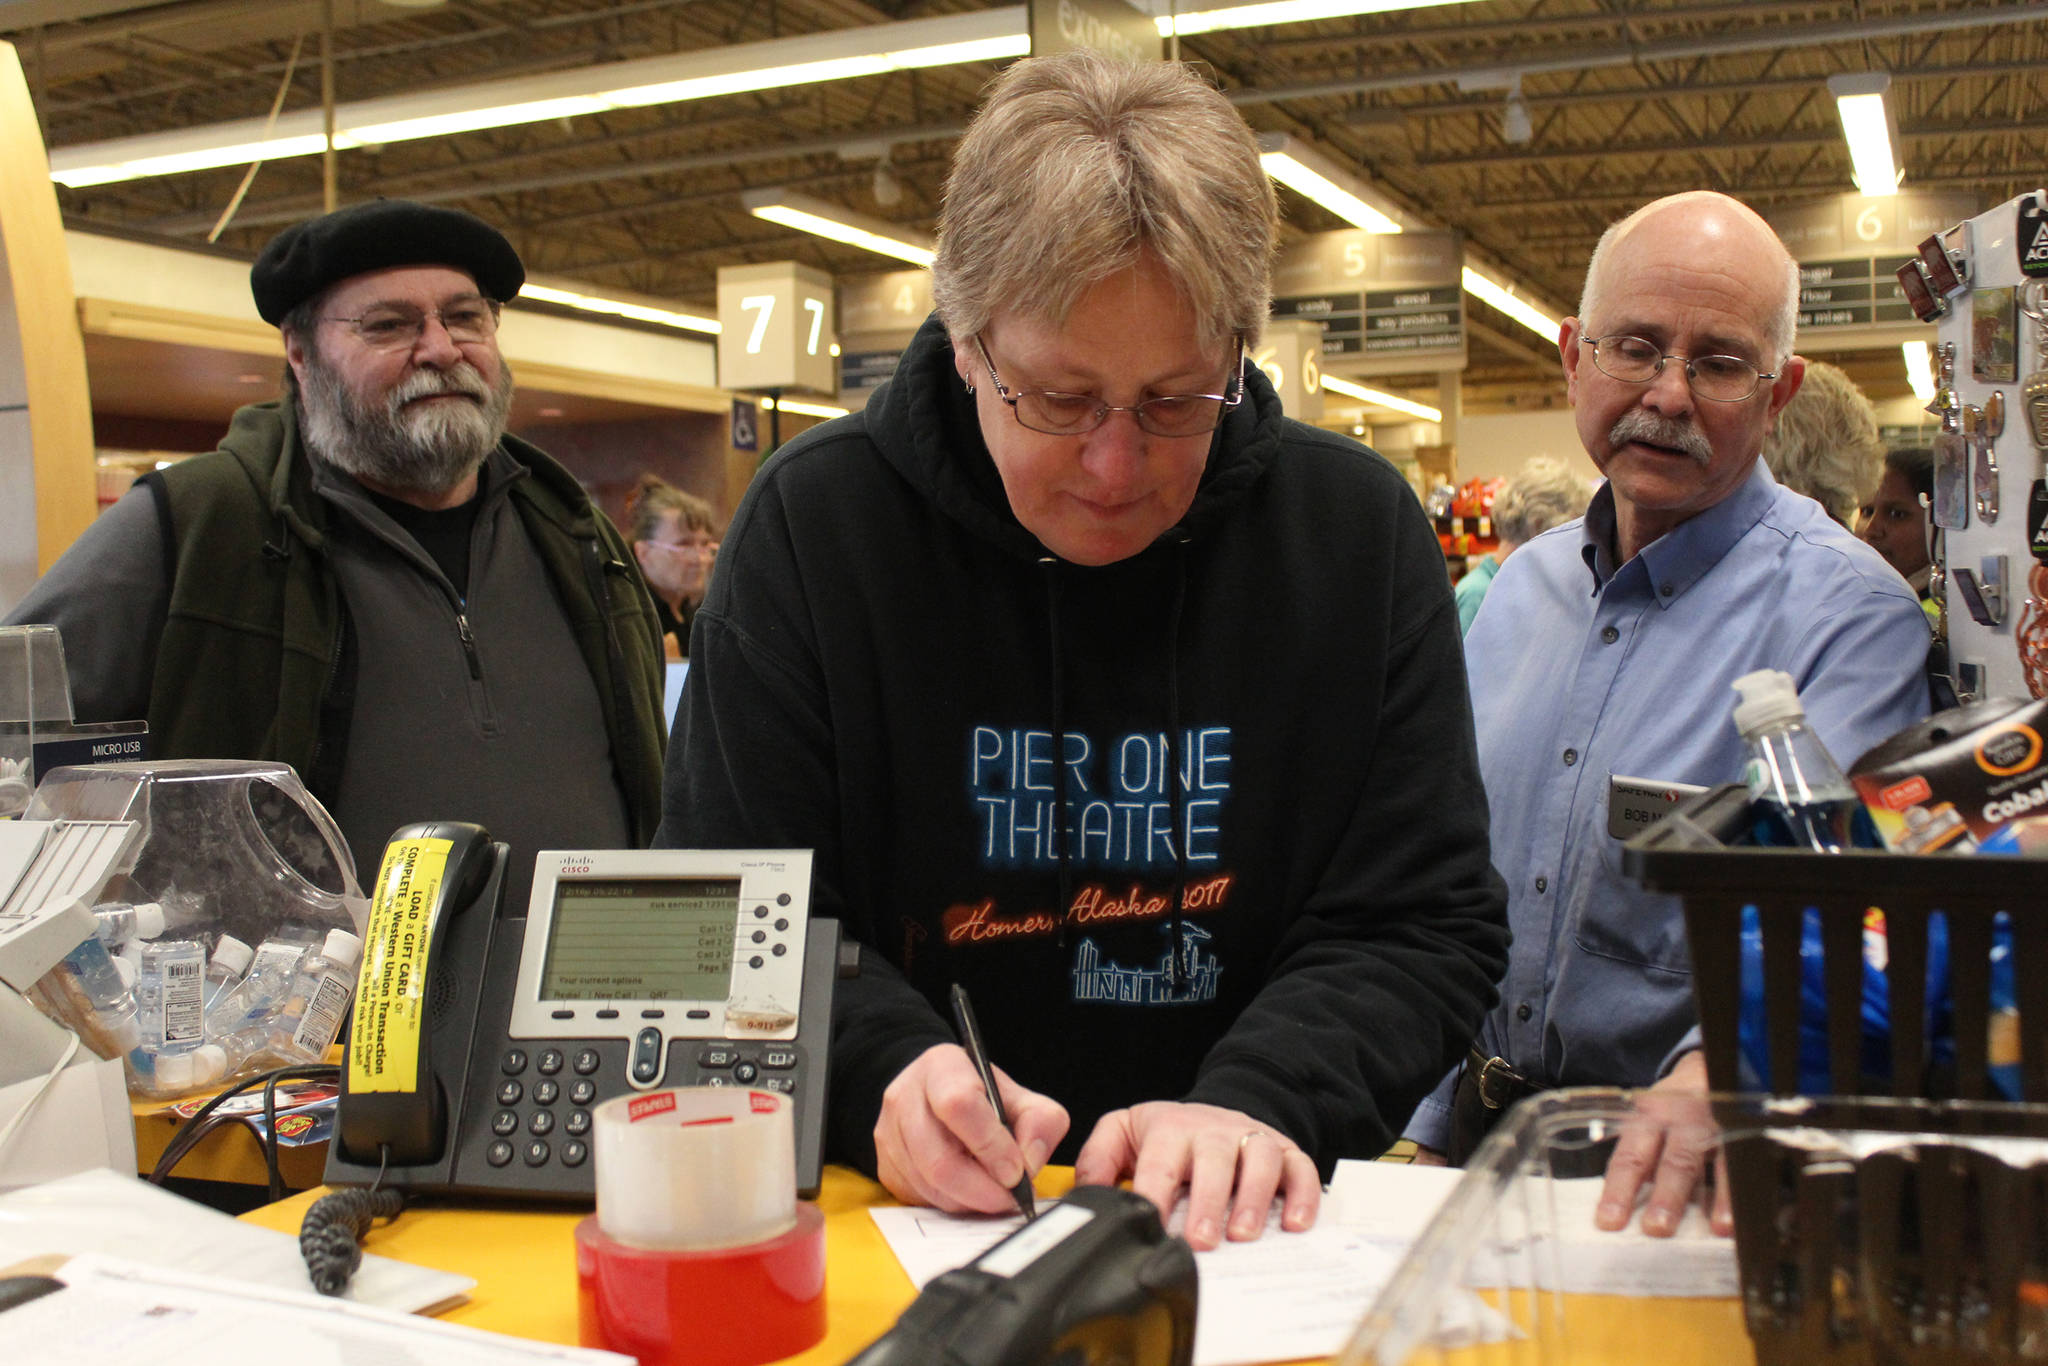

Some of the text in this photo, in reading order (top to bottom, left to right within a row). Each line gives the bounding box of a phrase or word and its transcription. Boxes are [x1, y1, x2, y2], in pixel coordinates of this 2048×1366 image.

[1856, 205, 1882, 241] 6
[1344, 243, 1366, 277] 5
[893, 285, 915, 314] 4
[741, 296, 776, 353] 7
[804, 298, 824, 356] 7
[1303, 349, 1319, 395] 6
[92, 741, 141, 756] MICRO USB
[973, 726, 1231, 794] PIER ONE
[1625, 808, 1649, 823] BOB
[977, 797, 1220, 862] THEATRE
[384, 867, 392, 880] NOT
[397, 847, 419, 898] COMPLETE
[409, 891, 422, 920] LOAD
[1066, 887, 1167, 922] Alaska
[371, 917, 379, 933] that
[387, 911, 403, 957] Western
[402, 933, 414, 959] GIFT
[418, 923, 429, 953] ANYONE
[381, 962, 395, 996] Union
[559, 976, 643, 985] Your current options
[361, 986, 369, 1002] NOT
[393, 1003, 403, 1014] or
[375, 1001, 390, 1074] Transaction
[511, 1054, 517, 1064] 1
[546, 1054, 554, 1064] 2
[583, 1054, 590, 1064] 3
[505, 1084, 513, 1094] 4
[542, 1083, 549, 1093] 5
[578, 1083, 586, 1093] 6
[501, 1114, 508, 1125] 7
[574, 1114, 582, 1125] 9
[532, 1145, 540, 1156] 0
